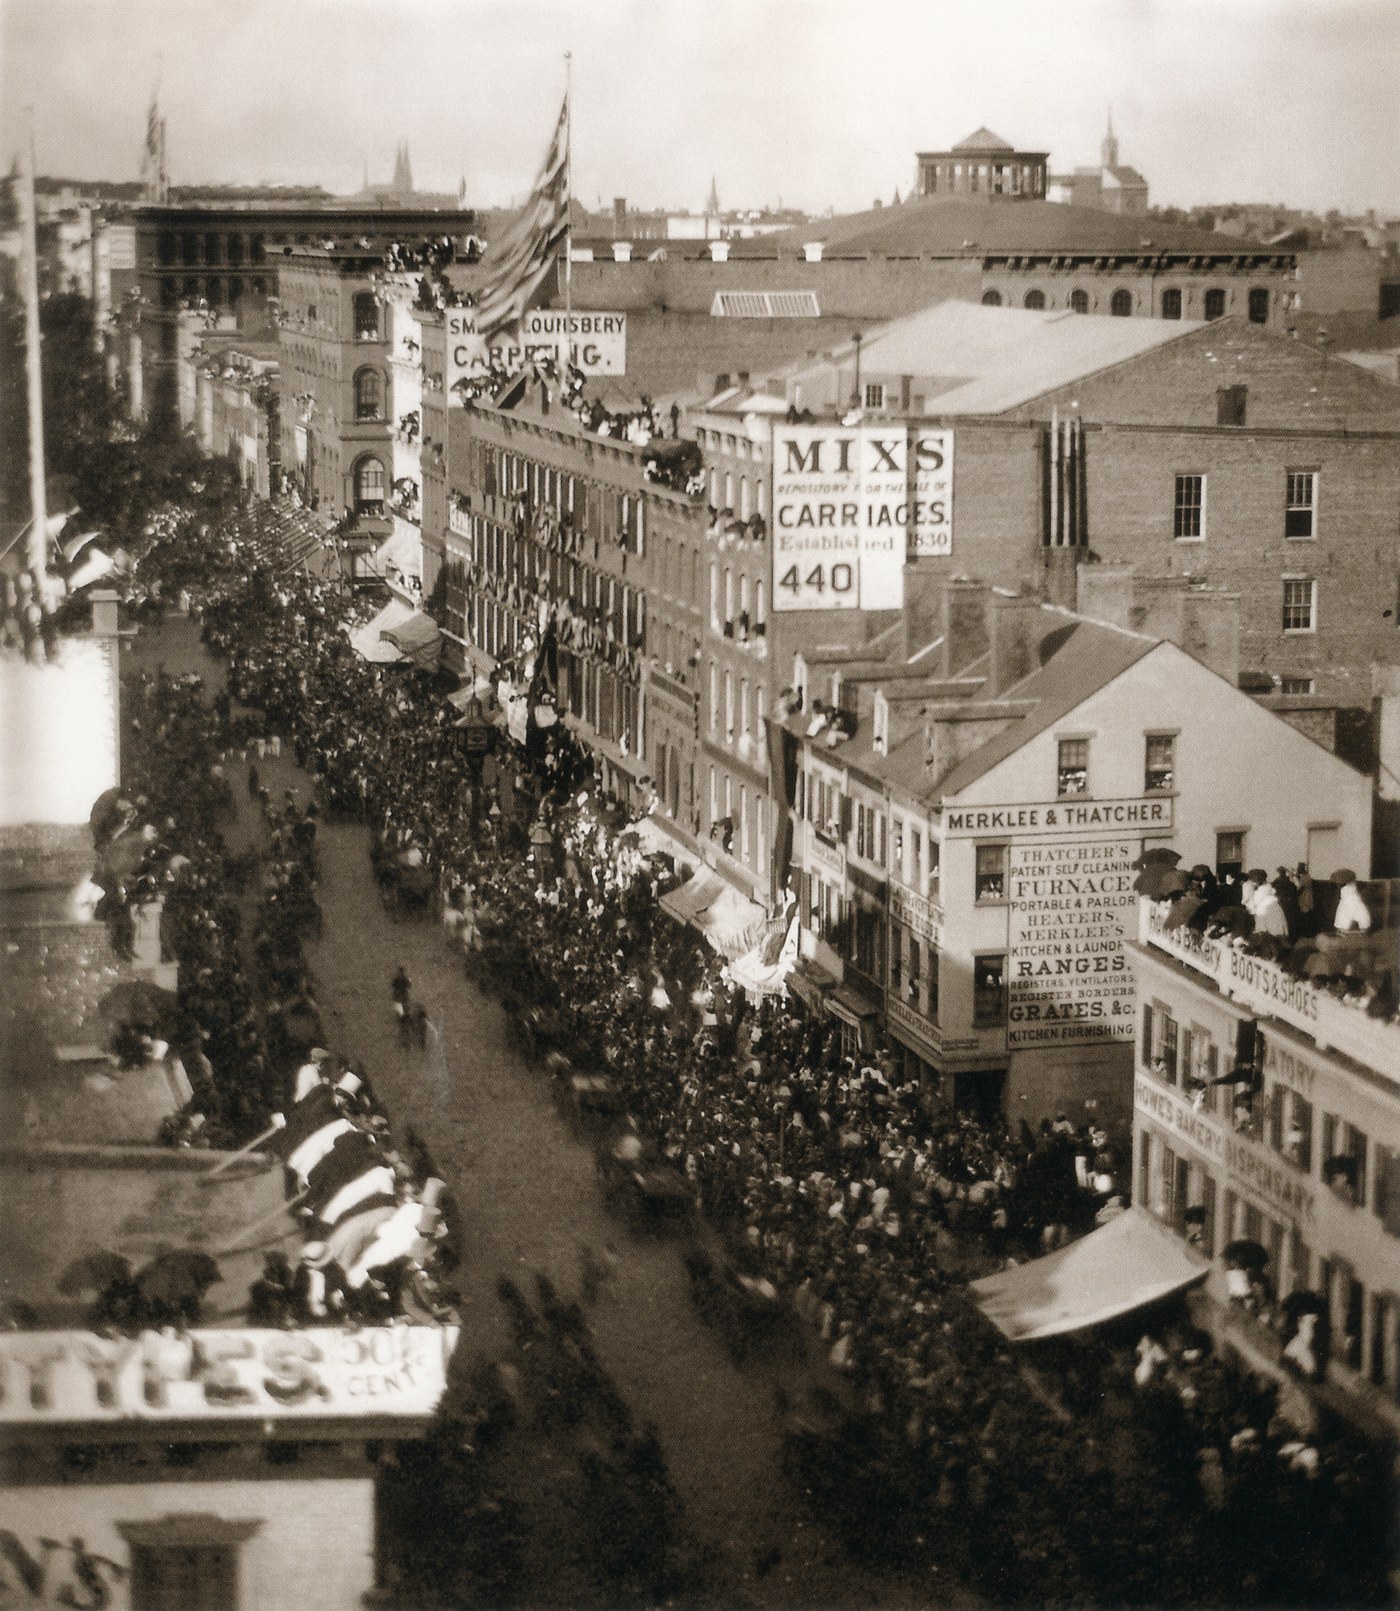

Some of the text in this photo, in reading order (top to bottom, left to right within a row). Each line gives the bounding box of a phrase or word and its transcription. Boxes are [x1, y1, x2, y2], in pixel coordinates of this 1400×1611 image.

[781, 438, 945, 475] MIX'S
[778, 501, 951, 529] CARRIAGES.
[779, 563, 852, 594] 440
[949, 810, 1038, 829] MERKLEE
[1045, 809, 1058, 826] &
[1021, 846, 1129, 862] THATCHER'S
[1011, 864, 1051, 877] PATENT
[1055, 863, 1079, 875] SELF
[1012, 895, 1136, 912] PORTABLE & PARLOR
[1020, 924, 1125, 940] MERKLEE'S
[1012, 944, 1062, 957] KITCHEN
[1065, 943, 1072, 954] &
[1010, 991, 1072, 1002] REGISTER
[1009, 1023, 1135, 1042] KITCHEN FURNISHING
